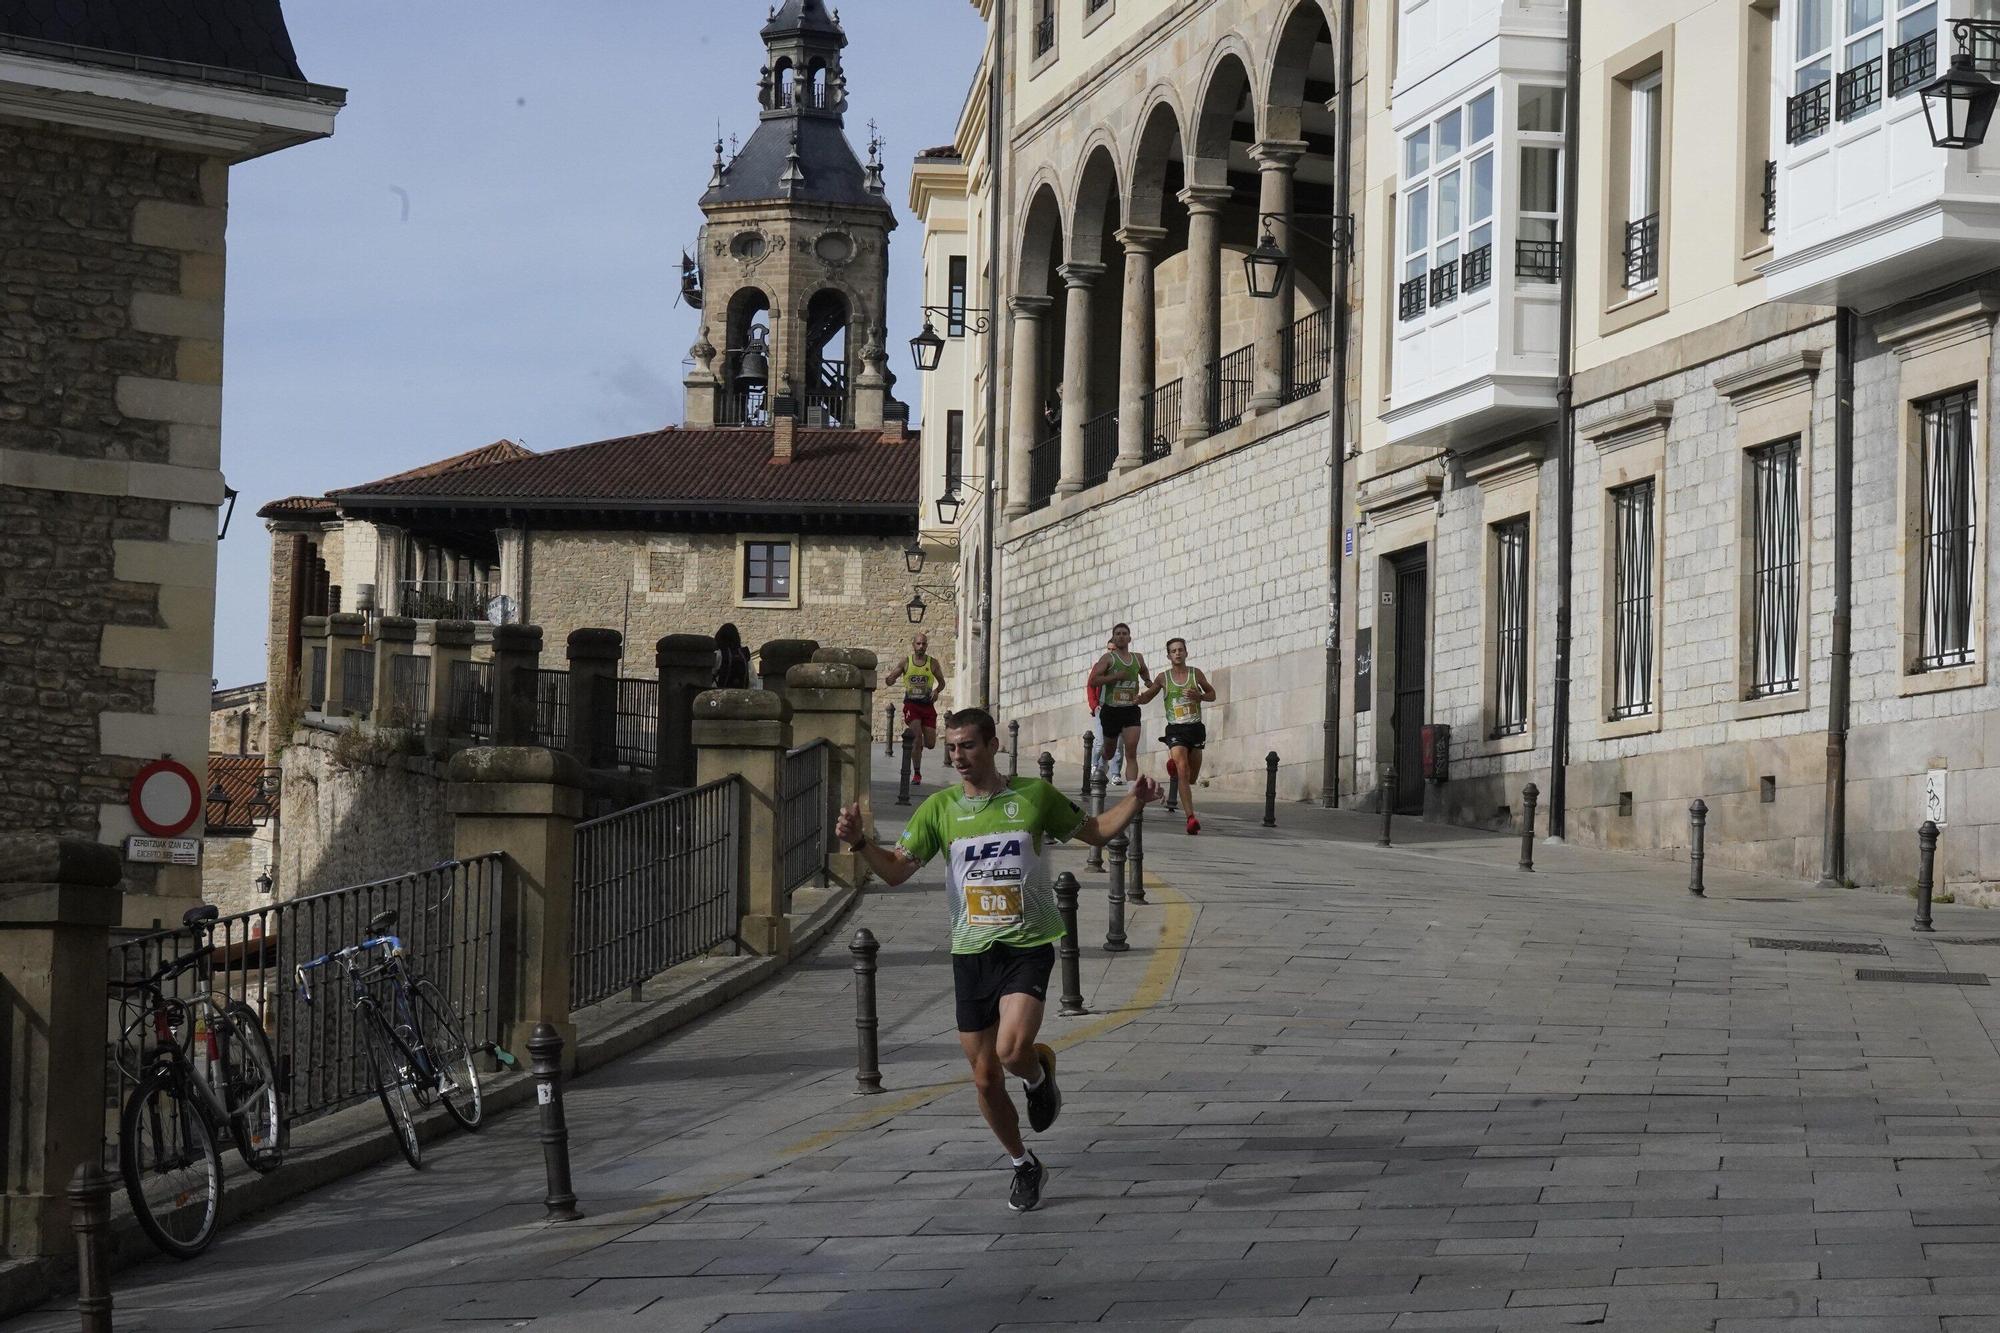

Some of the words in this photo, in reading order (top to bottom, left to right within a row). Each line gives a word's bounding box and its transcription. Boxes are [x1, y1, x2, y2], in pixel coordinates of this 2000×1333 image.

[134, 839, 167, 849] ZERBITZUAK
[168, 841, 182, 849] IZAN
[965, 840, 1020, 862] LEA
[981, 895, 1007, 911] 676
